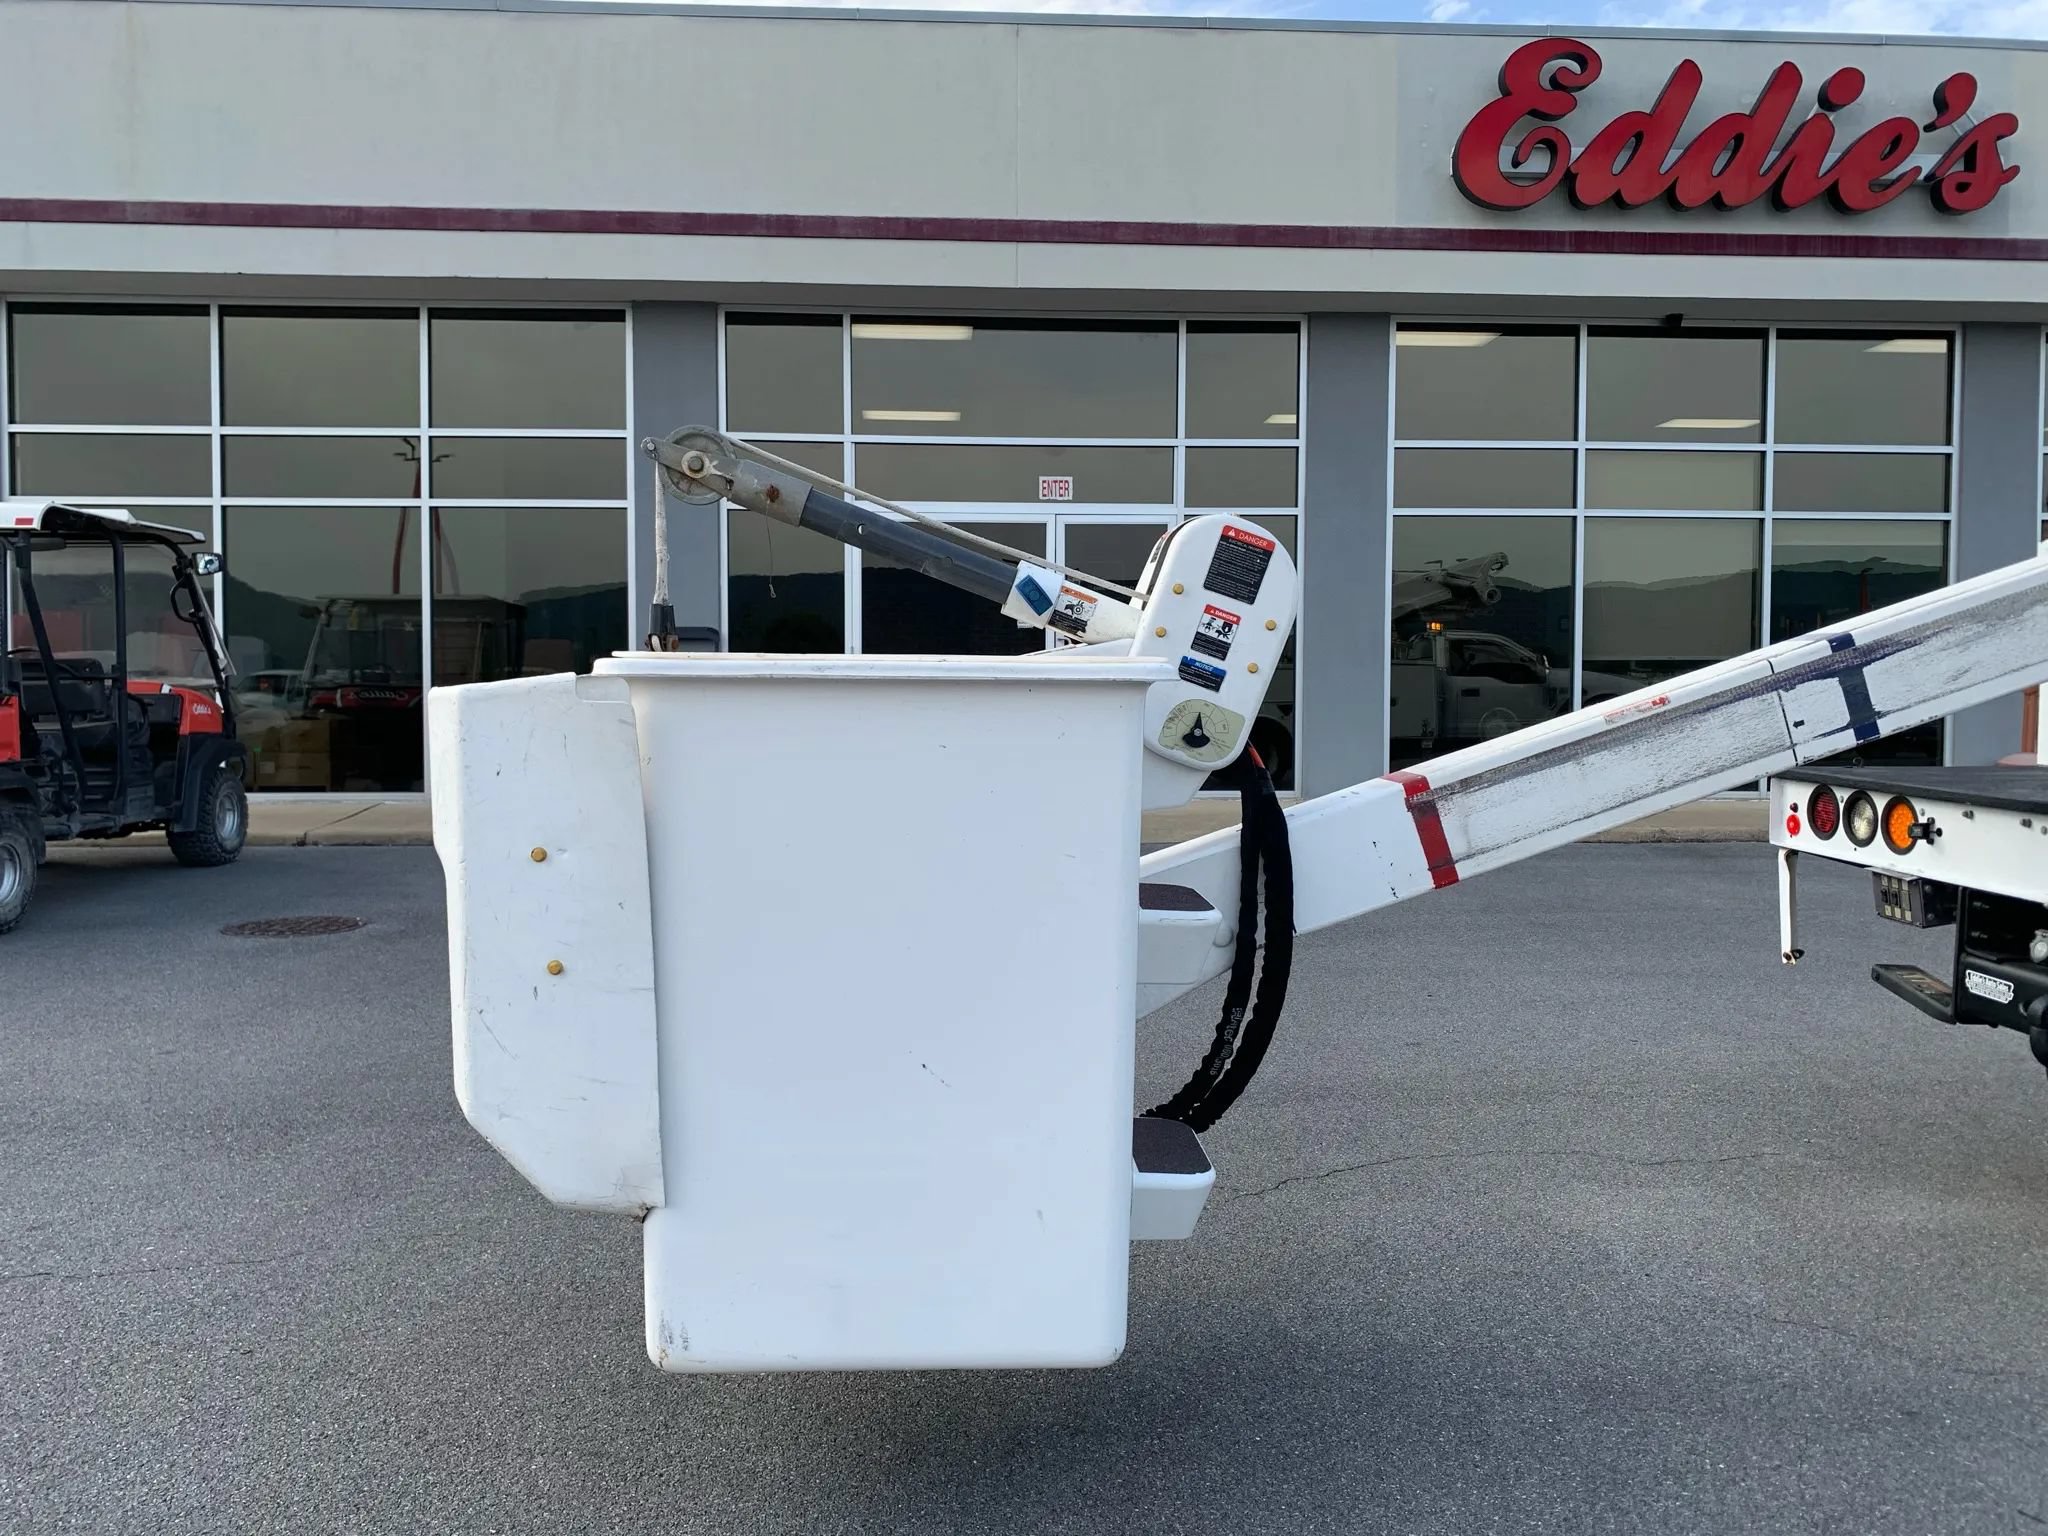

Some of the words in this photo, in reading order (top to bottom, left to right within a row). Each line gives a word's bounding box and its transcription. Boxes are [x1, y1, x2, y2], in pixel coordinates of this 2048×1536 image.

[1453, 37, 2020, 215] Eddie's
[1041, 479, 1070, 498] ENTER
[1238, 532, 1268, 548] DANGER
[1215, 609, 1238, 623] DANGER
[1194, 661, 1214, 672] NOTICE
